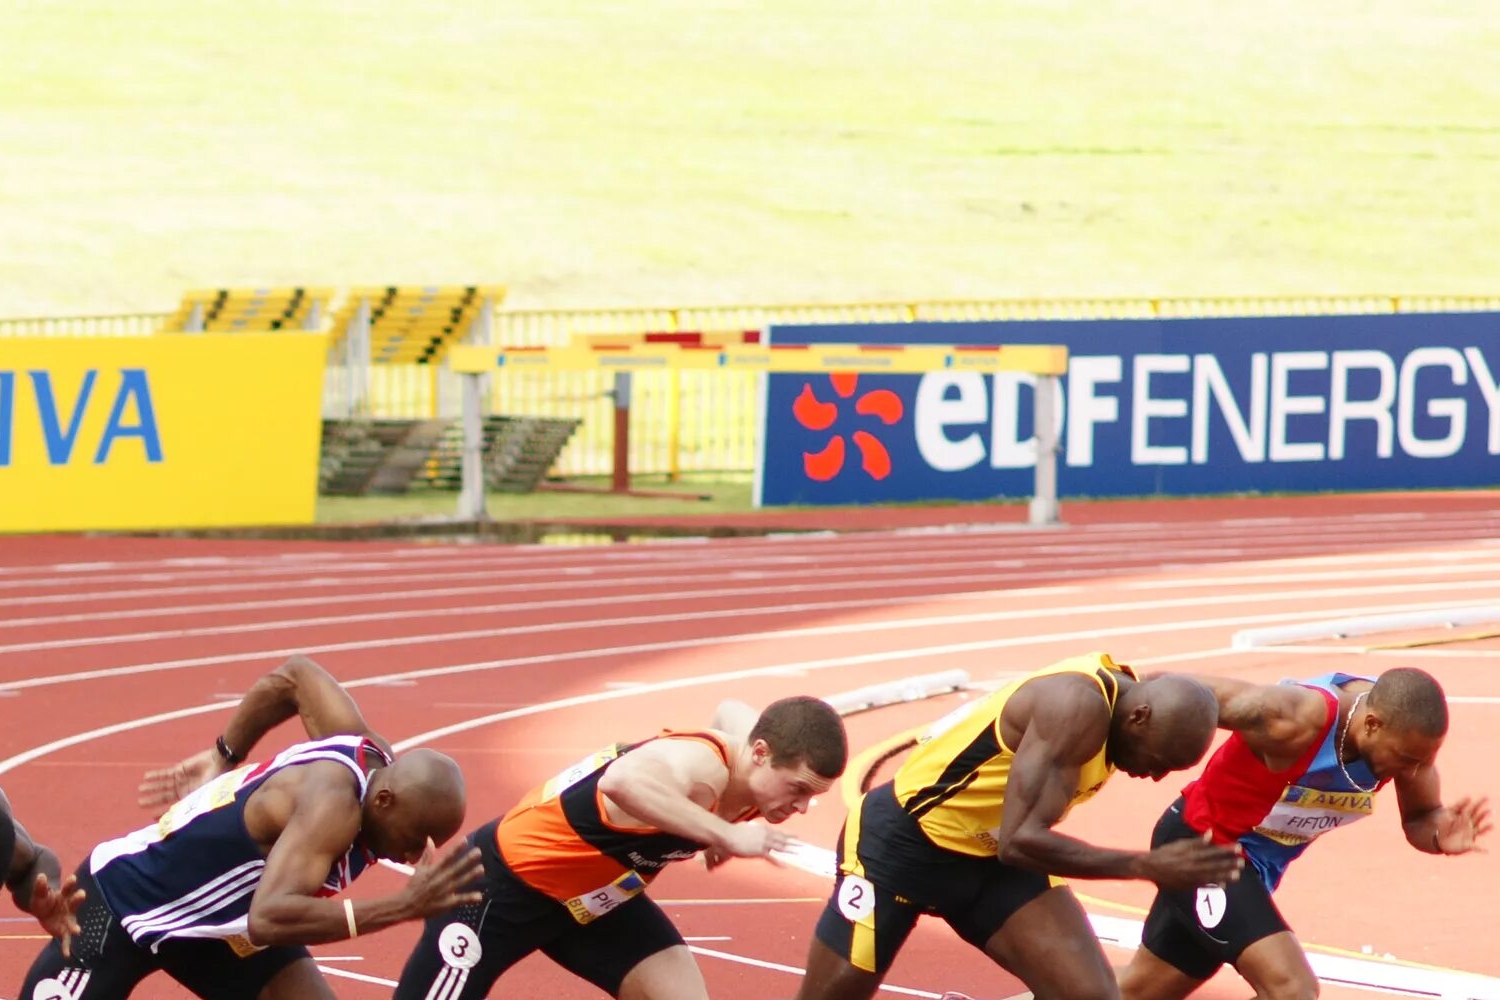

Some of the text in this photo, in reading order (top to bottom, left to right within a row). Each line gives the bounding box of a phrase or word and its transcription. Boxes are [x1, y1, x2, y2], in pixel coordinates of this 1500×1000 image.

[1312, 793, 1373, 810] AVIVA
[847, 884, 864, 909] 2
[1203, 893, 1213, 916] 1
[451, 936, 469, 959] 3
